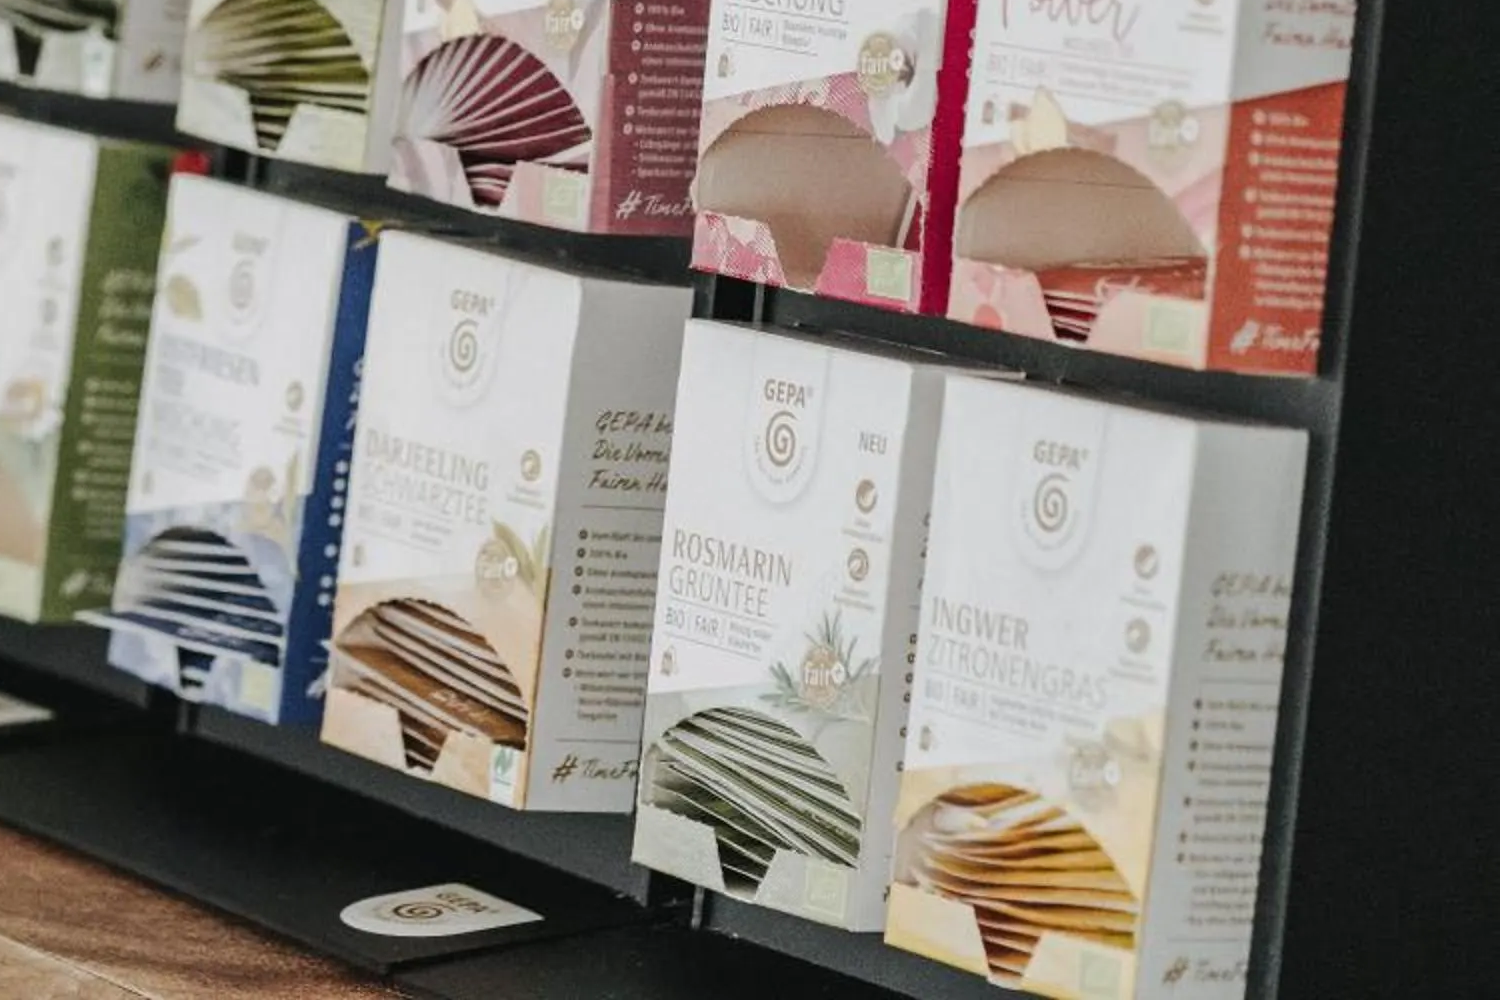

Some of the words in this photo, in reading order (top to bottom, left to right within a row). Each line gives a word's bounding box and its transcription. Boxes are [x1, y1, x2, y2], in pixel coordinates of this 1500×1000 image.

[366, 427, 488, 492] DARJEELING
[858, 431, 888, 455] NEU
[673, 528, 793, 587] ROSMARIN
[669, 564, 768, 618] GRÜNTEE
[932, 596, 1029, 651] INGWER
